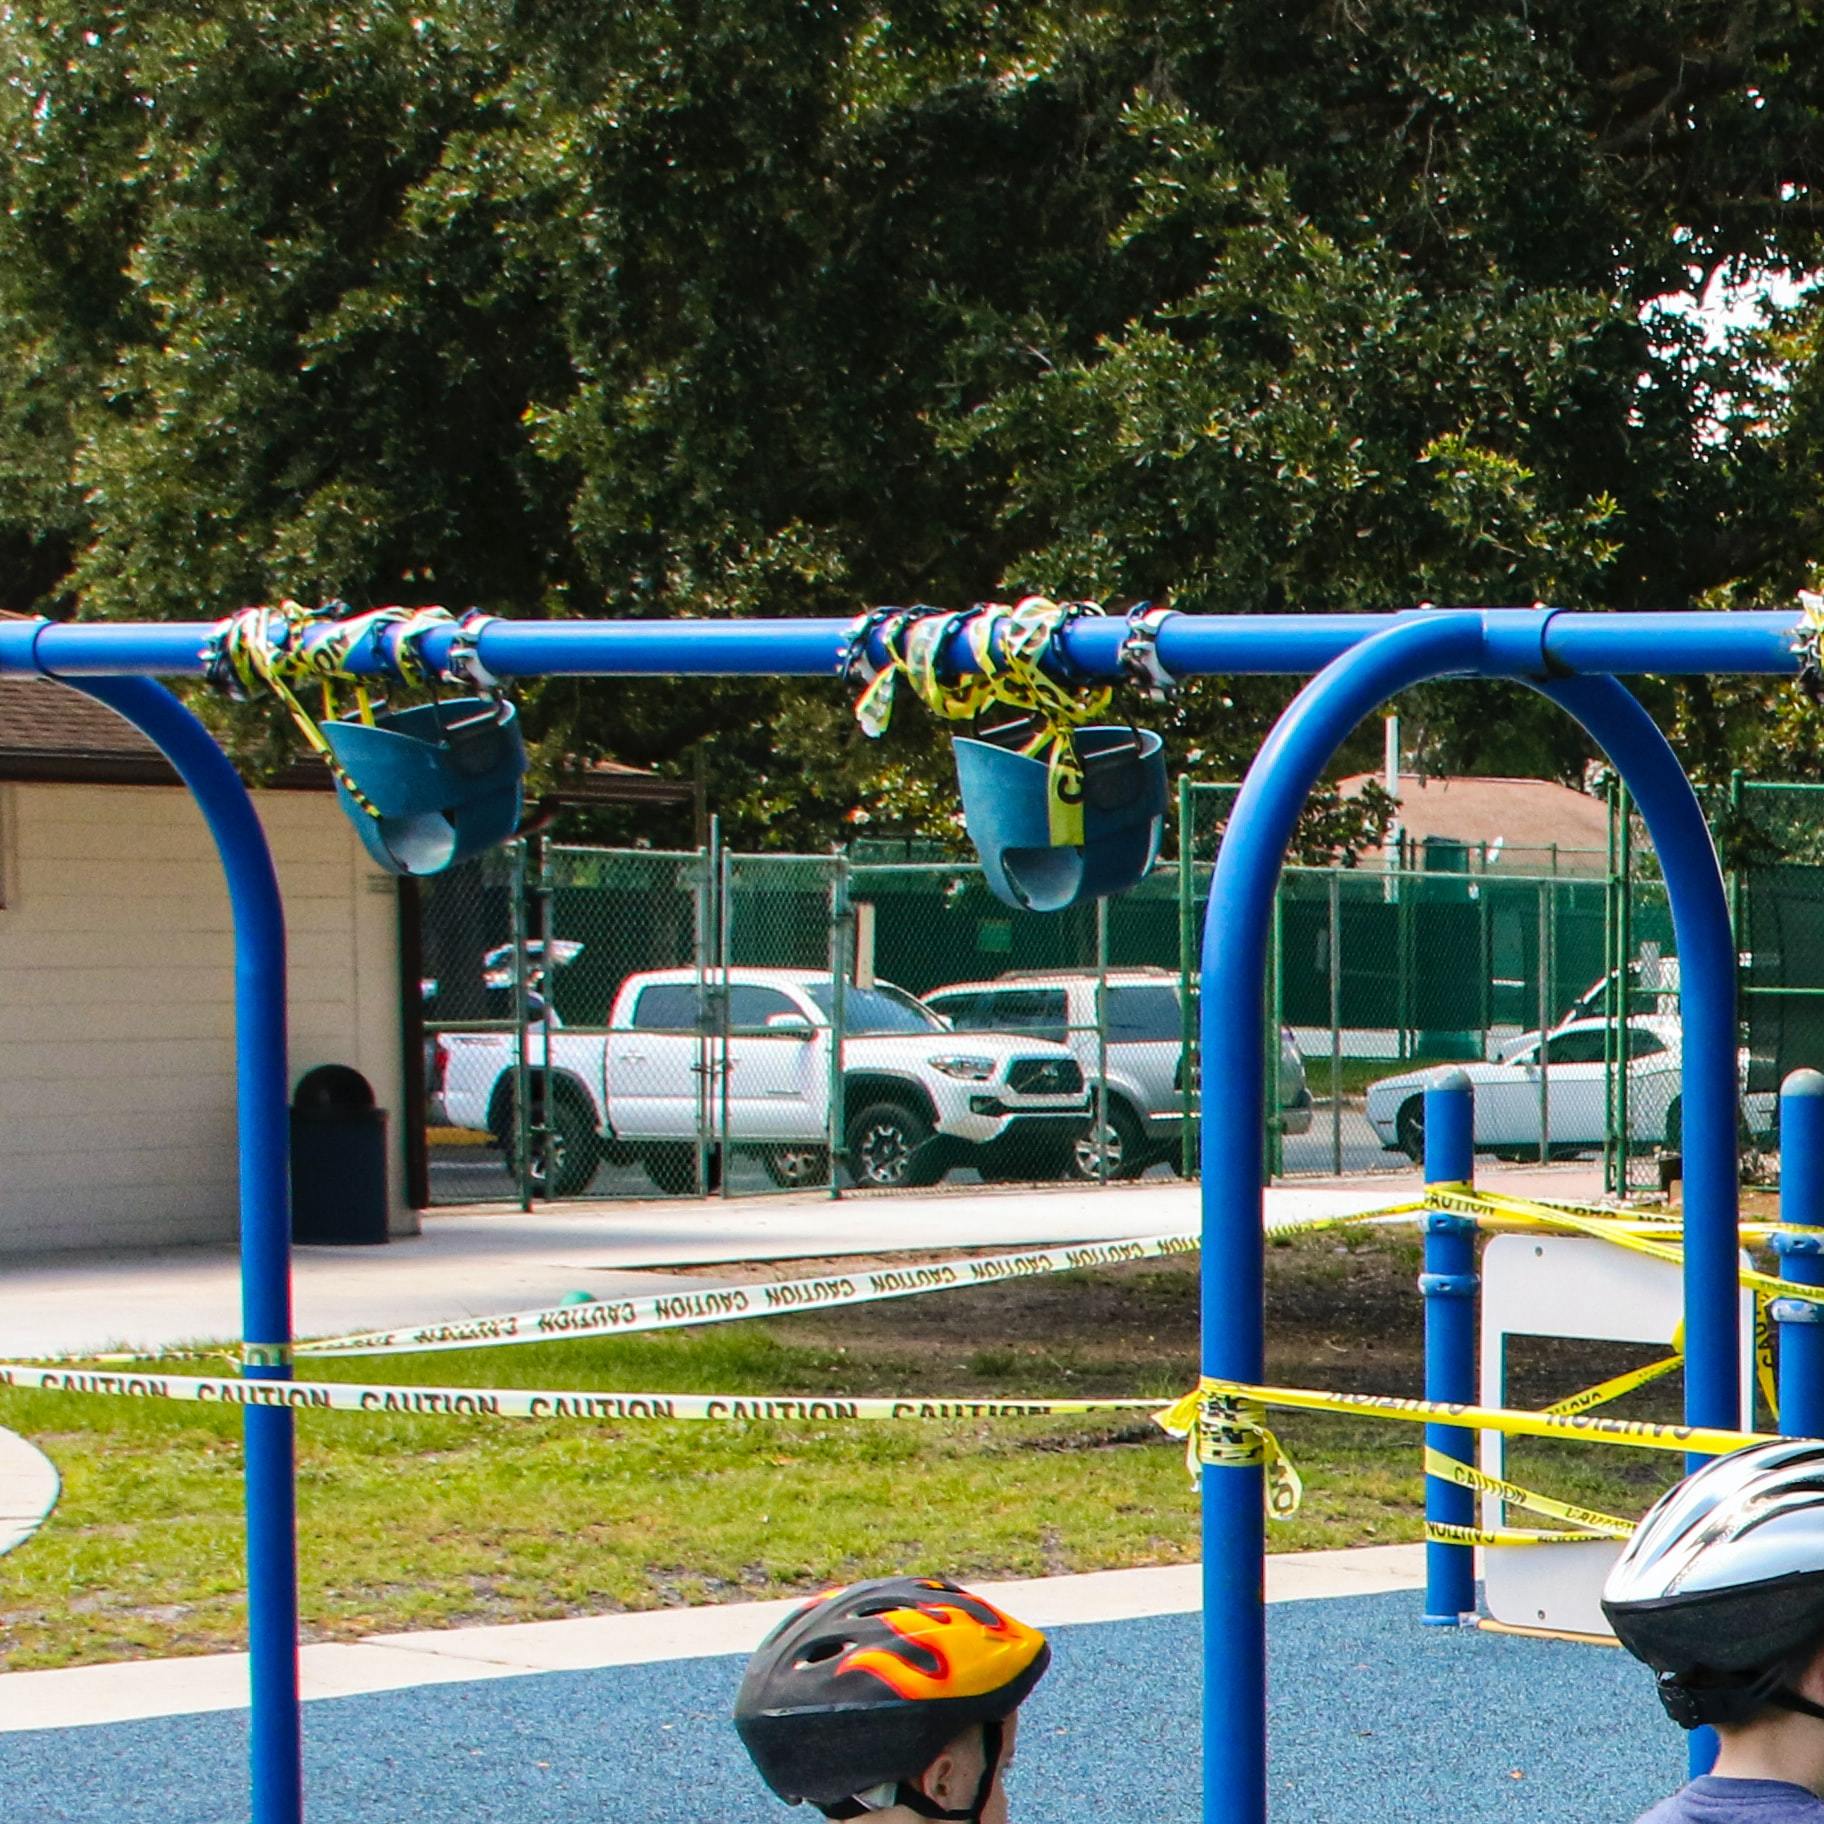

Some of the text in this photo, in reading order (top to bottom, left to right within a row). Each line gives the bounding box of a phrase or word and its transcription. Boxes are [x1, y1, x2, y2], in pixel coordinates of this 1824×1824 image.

[538, 1301, 636, 1332] CAUTION
[655, 1289, 748, 1321] CAUTION
[764, 1278, 855, 1306] CAUTION
[869, 1265, 957, 1291] CAUTION
[971, 1254, 1053, 1278] CAUTION
[1065, 1242, 1145, 1267] CAUTION
[1454, 1465, 1527, 1504] CAUTION
